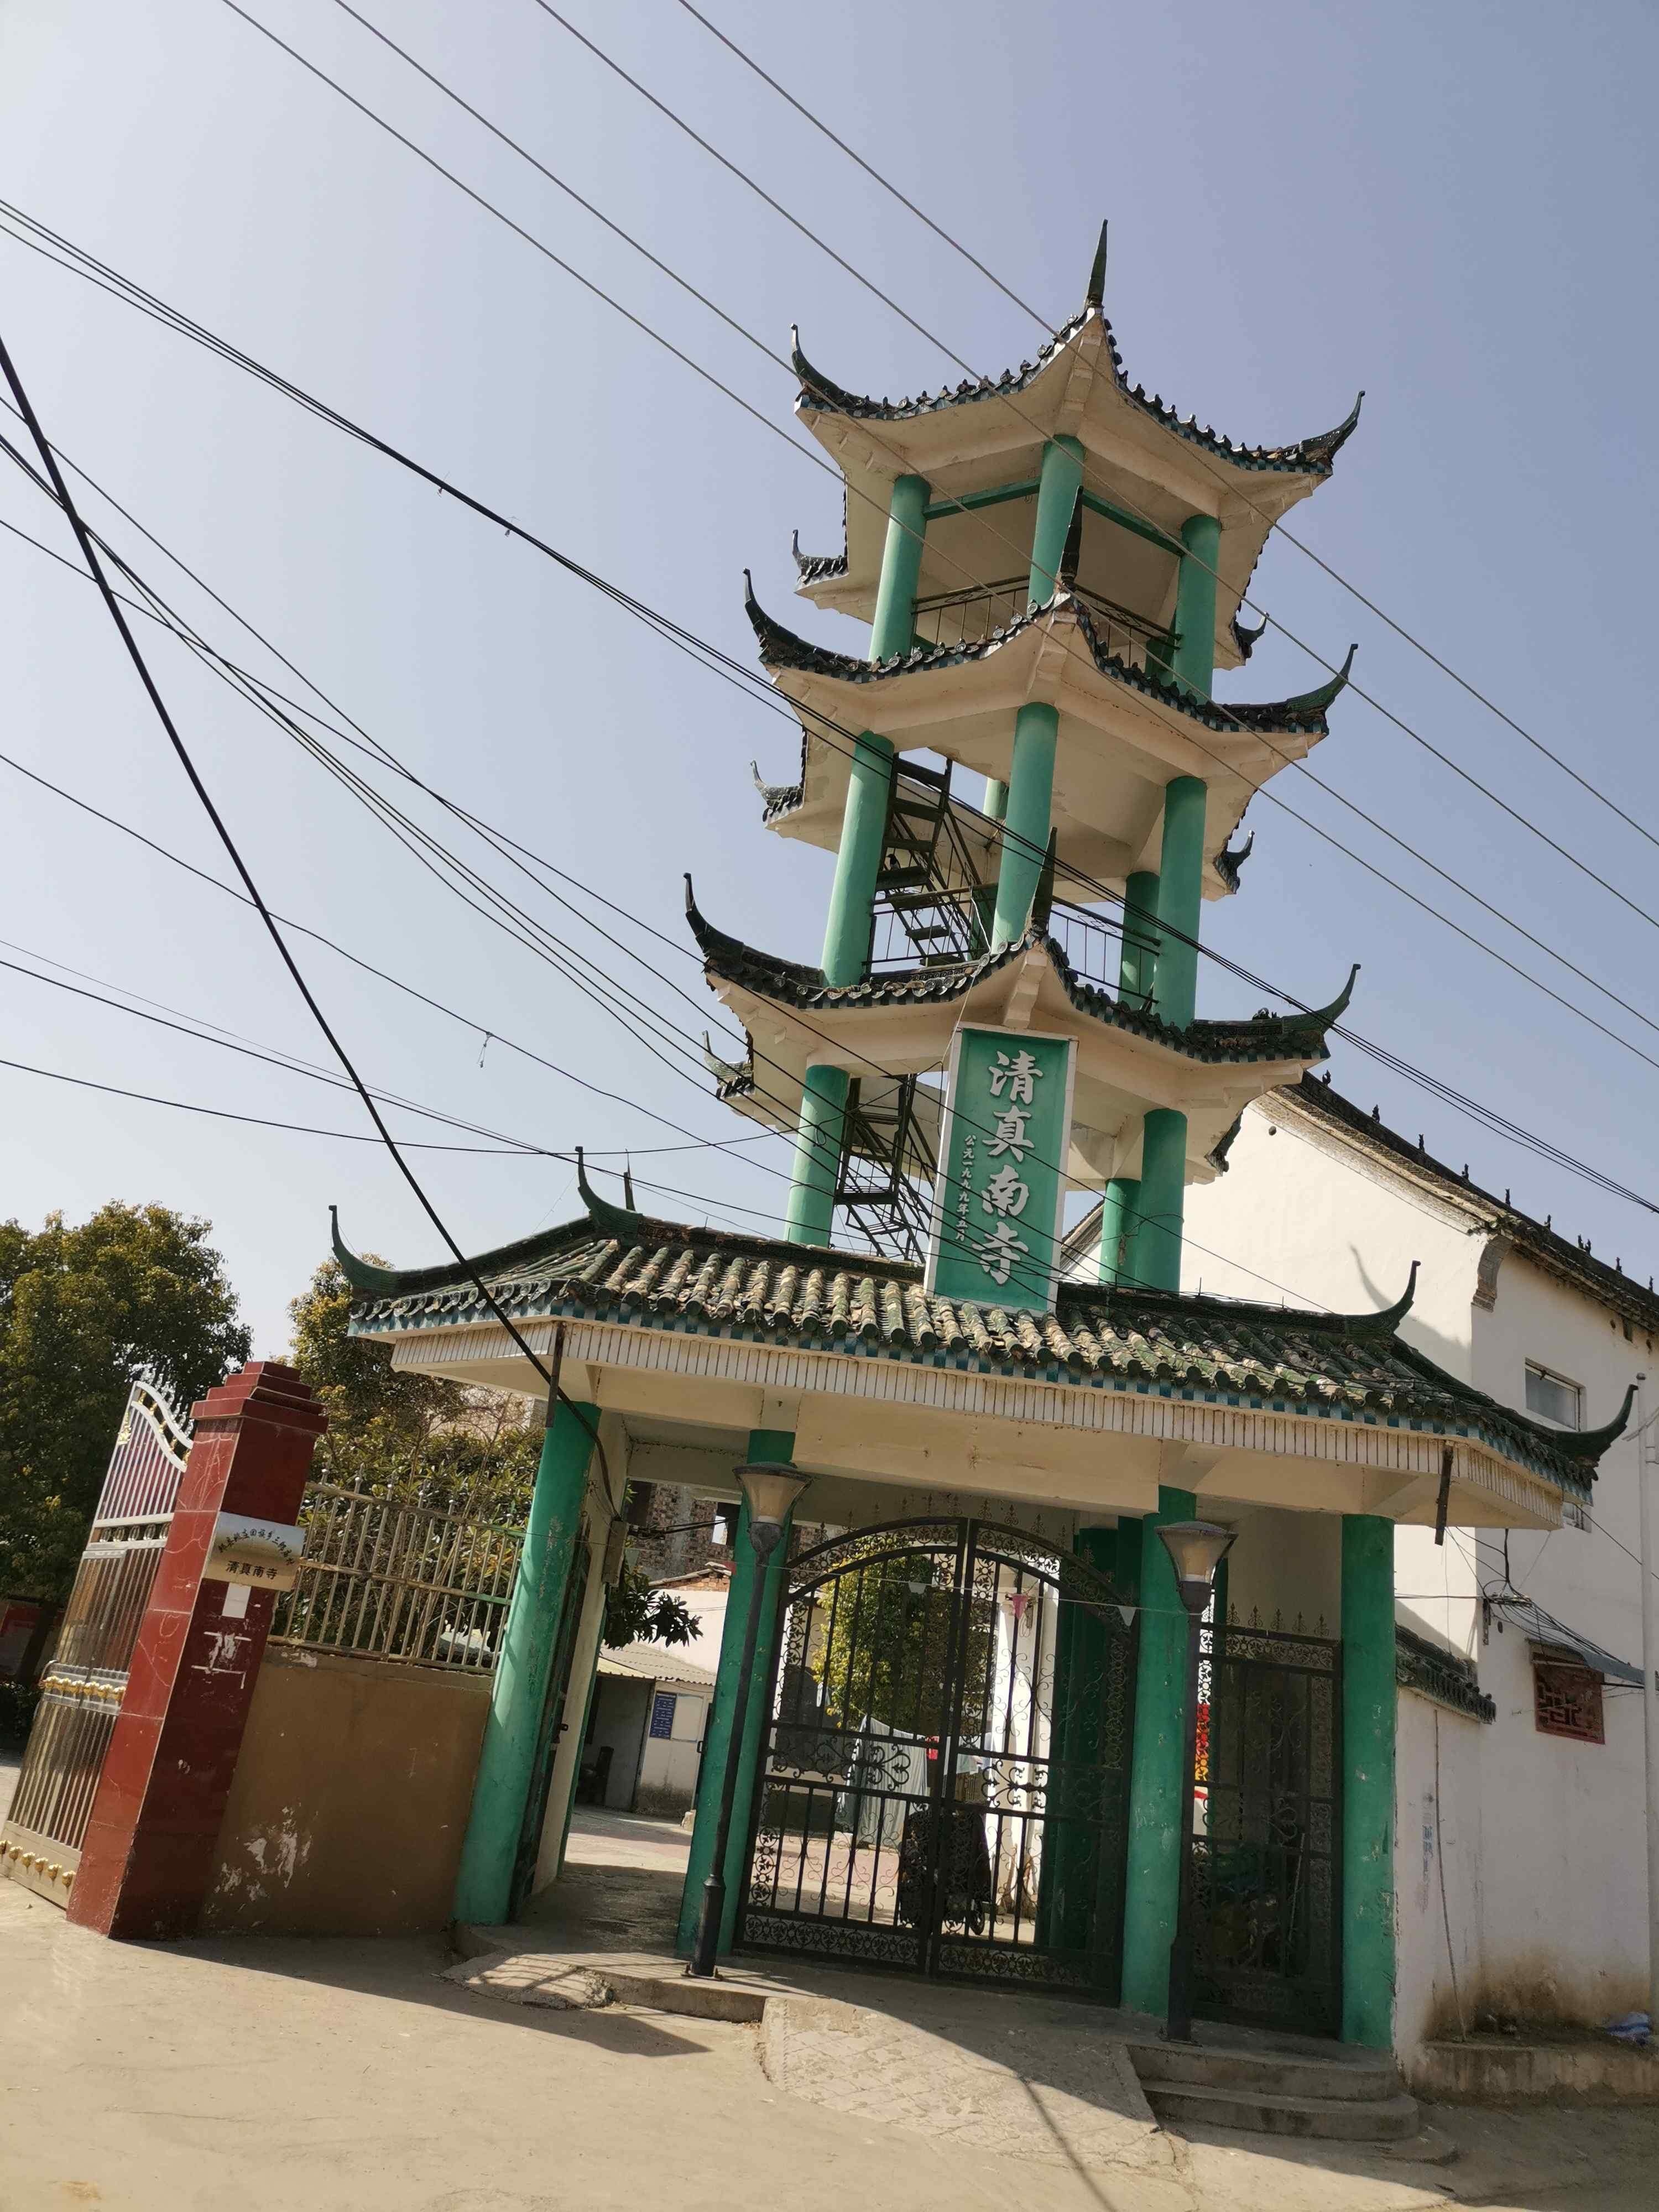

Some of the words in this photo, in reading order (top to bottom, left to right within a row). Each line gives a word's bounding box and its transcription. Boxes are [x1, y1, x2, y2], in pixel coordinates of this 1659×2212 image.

[955, 1134, 977, 1241] 公元一九九九年五月
[972, 1049, 1043, 1285] 清真南寺
[225, 1560, 278, 1580] 清真南寺
